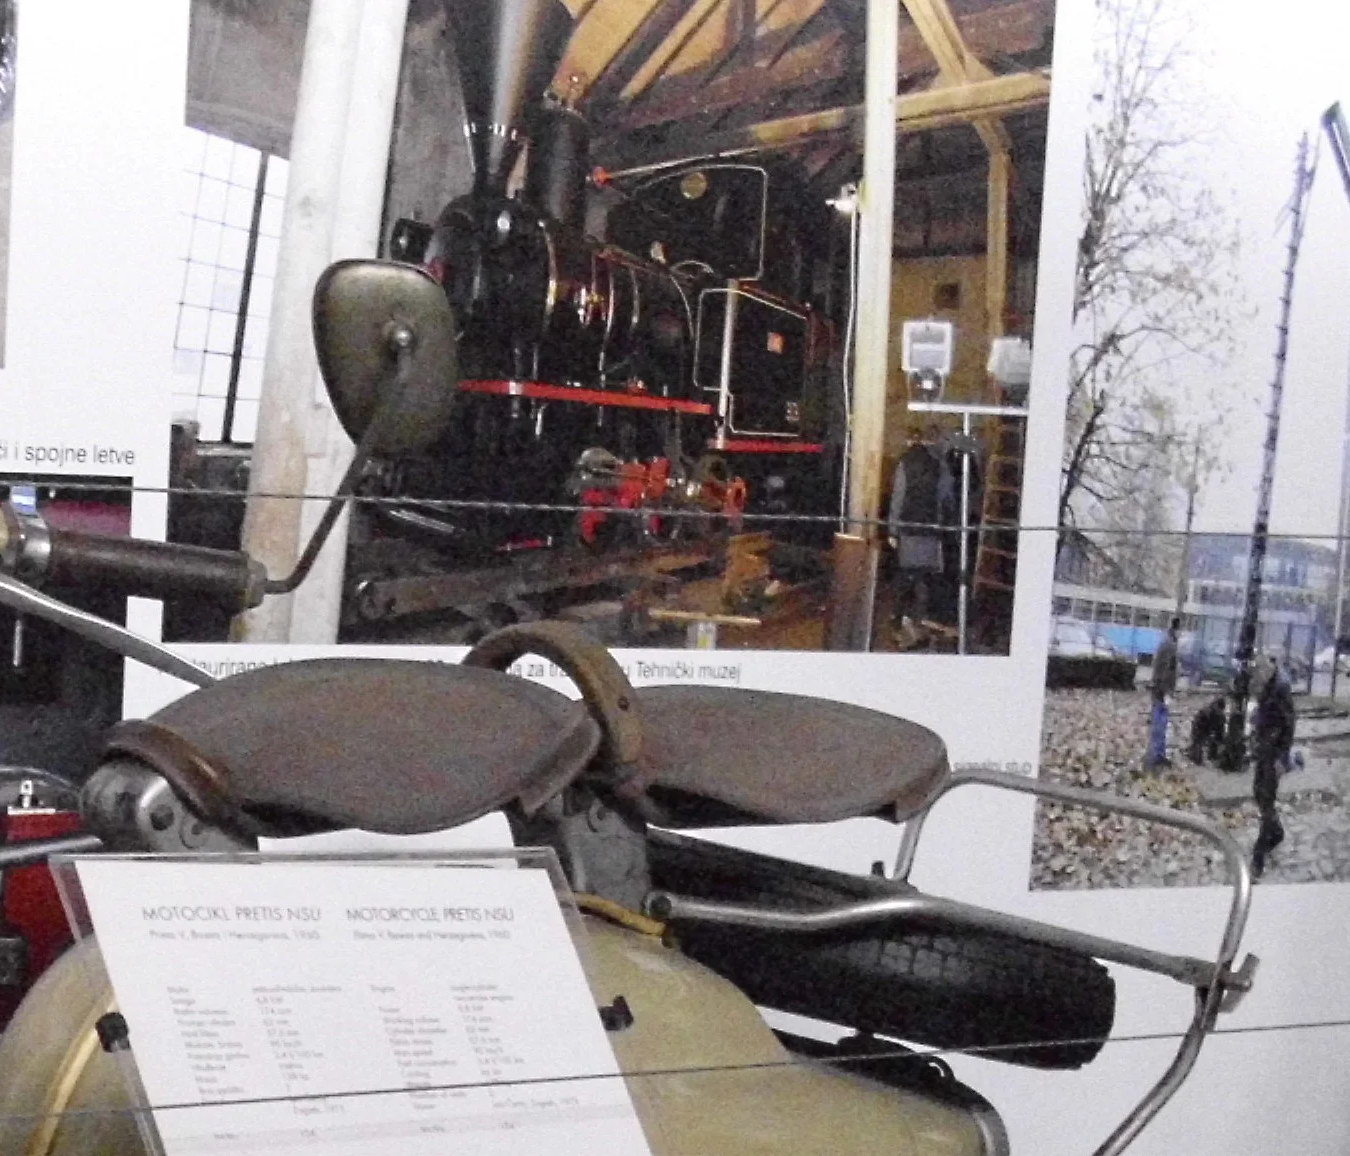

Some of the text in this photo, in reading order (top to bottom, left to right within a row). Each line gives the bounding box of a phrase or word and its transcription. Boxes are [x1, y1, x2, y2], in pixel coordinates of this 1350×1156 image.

[13, 440, 19, 460] i
[25, 442, 86, 467] spojne
[93, 445, 135, 465] letve
[636, 660, 694, 679] Tehnički
[699, 662, 742, 684] muzej
[142, 906, 322, 921] MOTOCIKL PRETIS NSU
[346, 907, 515, 923] MOTORCYCLE PRETIS NSU
